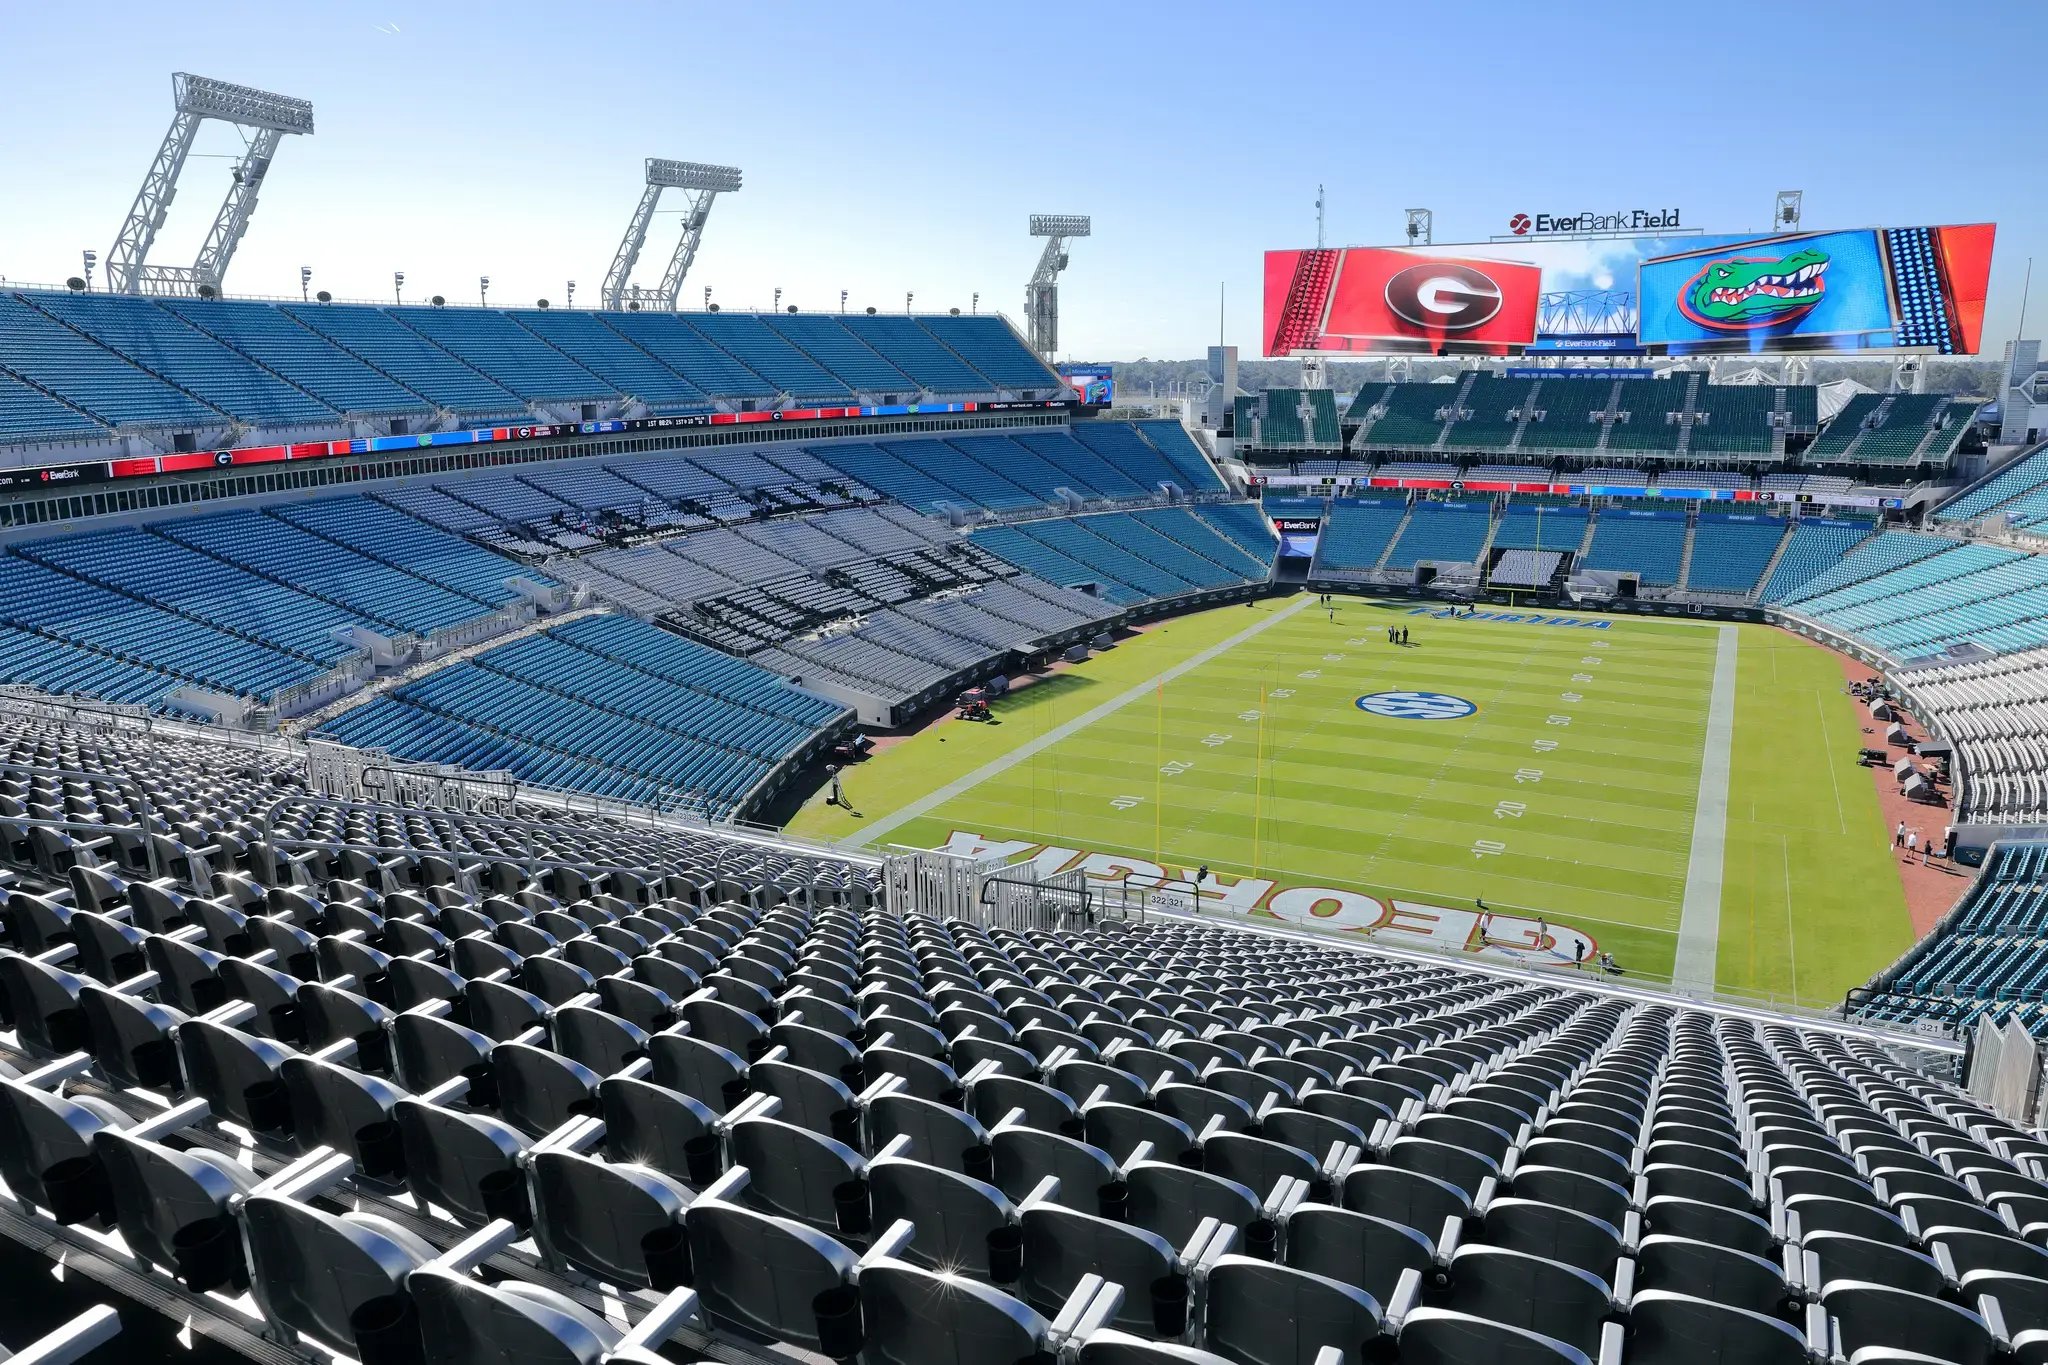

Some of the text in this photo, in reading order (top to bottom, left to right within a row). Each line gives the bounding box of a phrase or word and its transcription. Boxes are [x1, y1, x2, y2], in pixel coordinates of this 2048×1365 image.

[1536, 208, 1680, 231] EverBank Field
[49, 469, 80, 480] EverBank
[1284, 521, 1317, 529] EverBank
[1200, 733, 1232, 746] 30
[1160, 760, 1194, 775] 20
[1514, 768, 1544, 783] 30
[1110, 795, 1144, 809] 10
[1493, 800, 1527, 818] 20
[1471, 839, 1506, 857] 10
[1151, 895, 1183, 908] 322 321
[1920, 1023, 1938, 1033] 321
